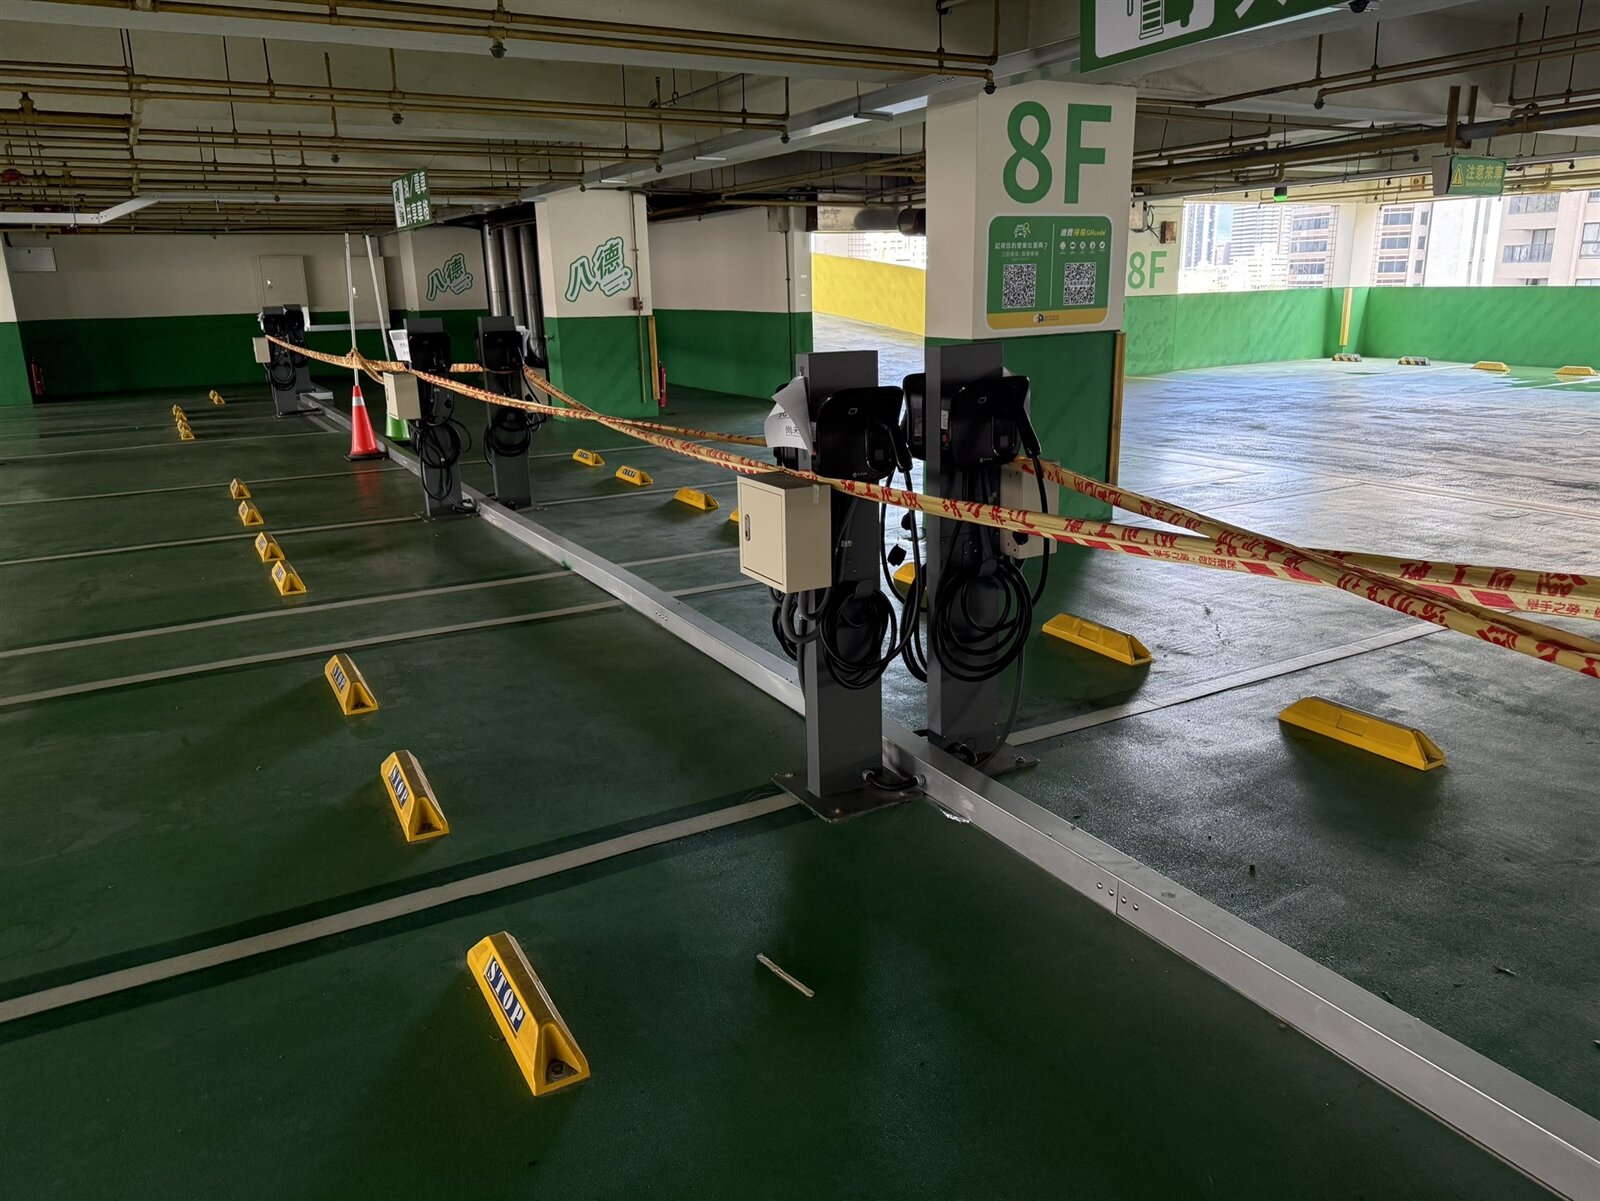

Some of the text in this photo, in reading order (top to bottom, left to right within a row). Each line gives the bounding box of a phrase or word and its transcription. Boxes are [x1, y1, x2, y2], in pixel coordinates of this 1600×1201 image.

[1003, 101, 1112, 204] 8F
[1466, 164, 1504, 180] 注意來車
[429, 256, 464, 298] 八德
[568, 240, 621, 298] 八德
[1127, 250, 1168, 289] 8F
[332, 665, 346, 689] STOP
[390, 766, 409, 803] STOP
[487, 960, 524, 1025] STOP
